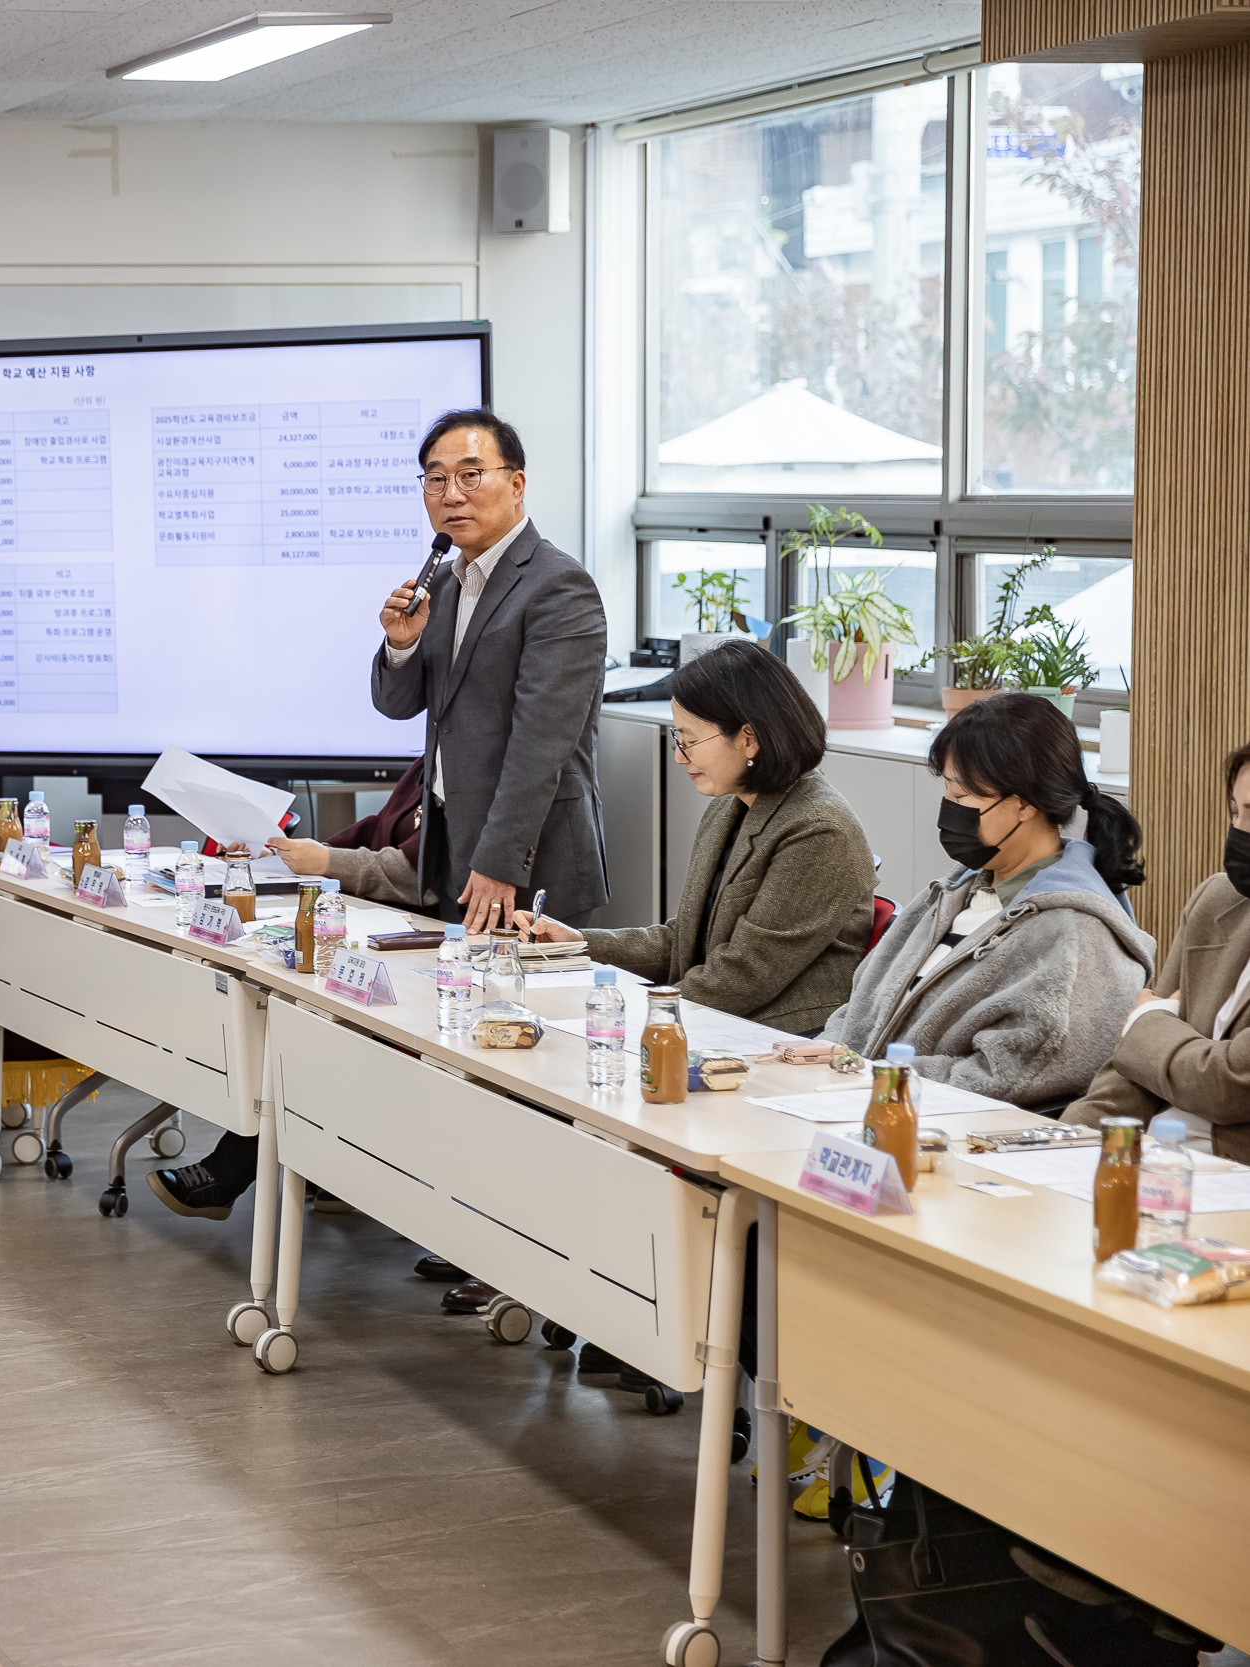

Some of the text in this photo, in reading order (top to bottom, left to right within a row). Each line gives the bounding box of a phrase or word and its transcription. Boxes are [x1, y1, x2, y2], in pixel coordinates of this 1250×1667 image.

[3, 368, 23, 380] 학교
[26, 367, 47, 379] 예산
[51, 366, 71, 378] 지원
[74, 365, 96, 377] 사항
[282, 411, 298, 421] 금액
[360, 409, 378, 419] 비고
[53, 416, 69, 426] 비고
[819, 1146, 873, 1186] 학교관계자
